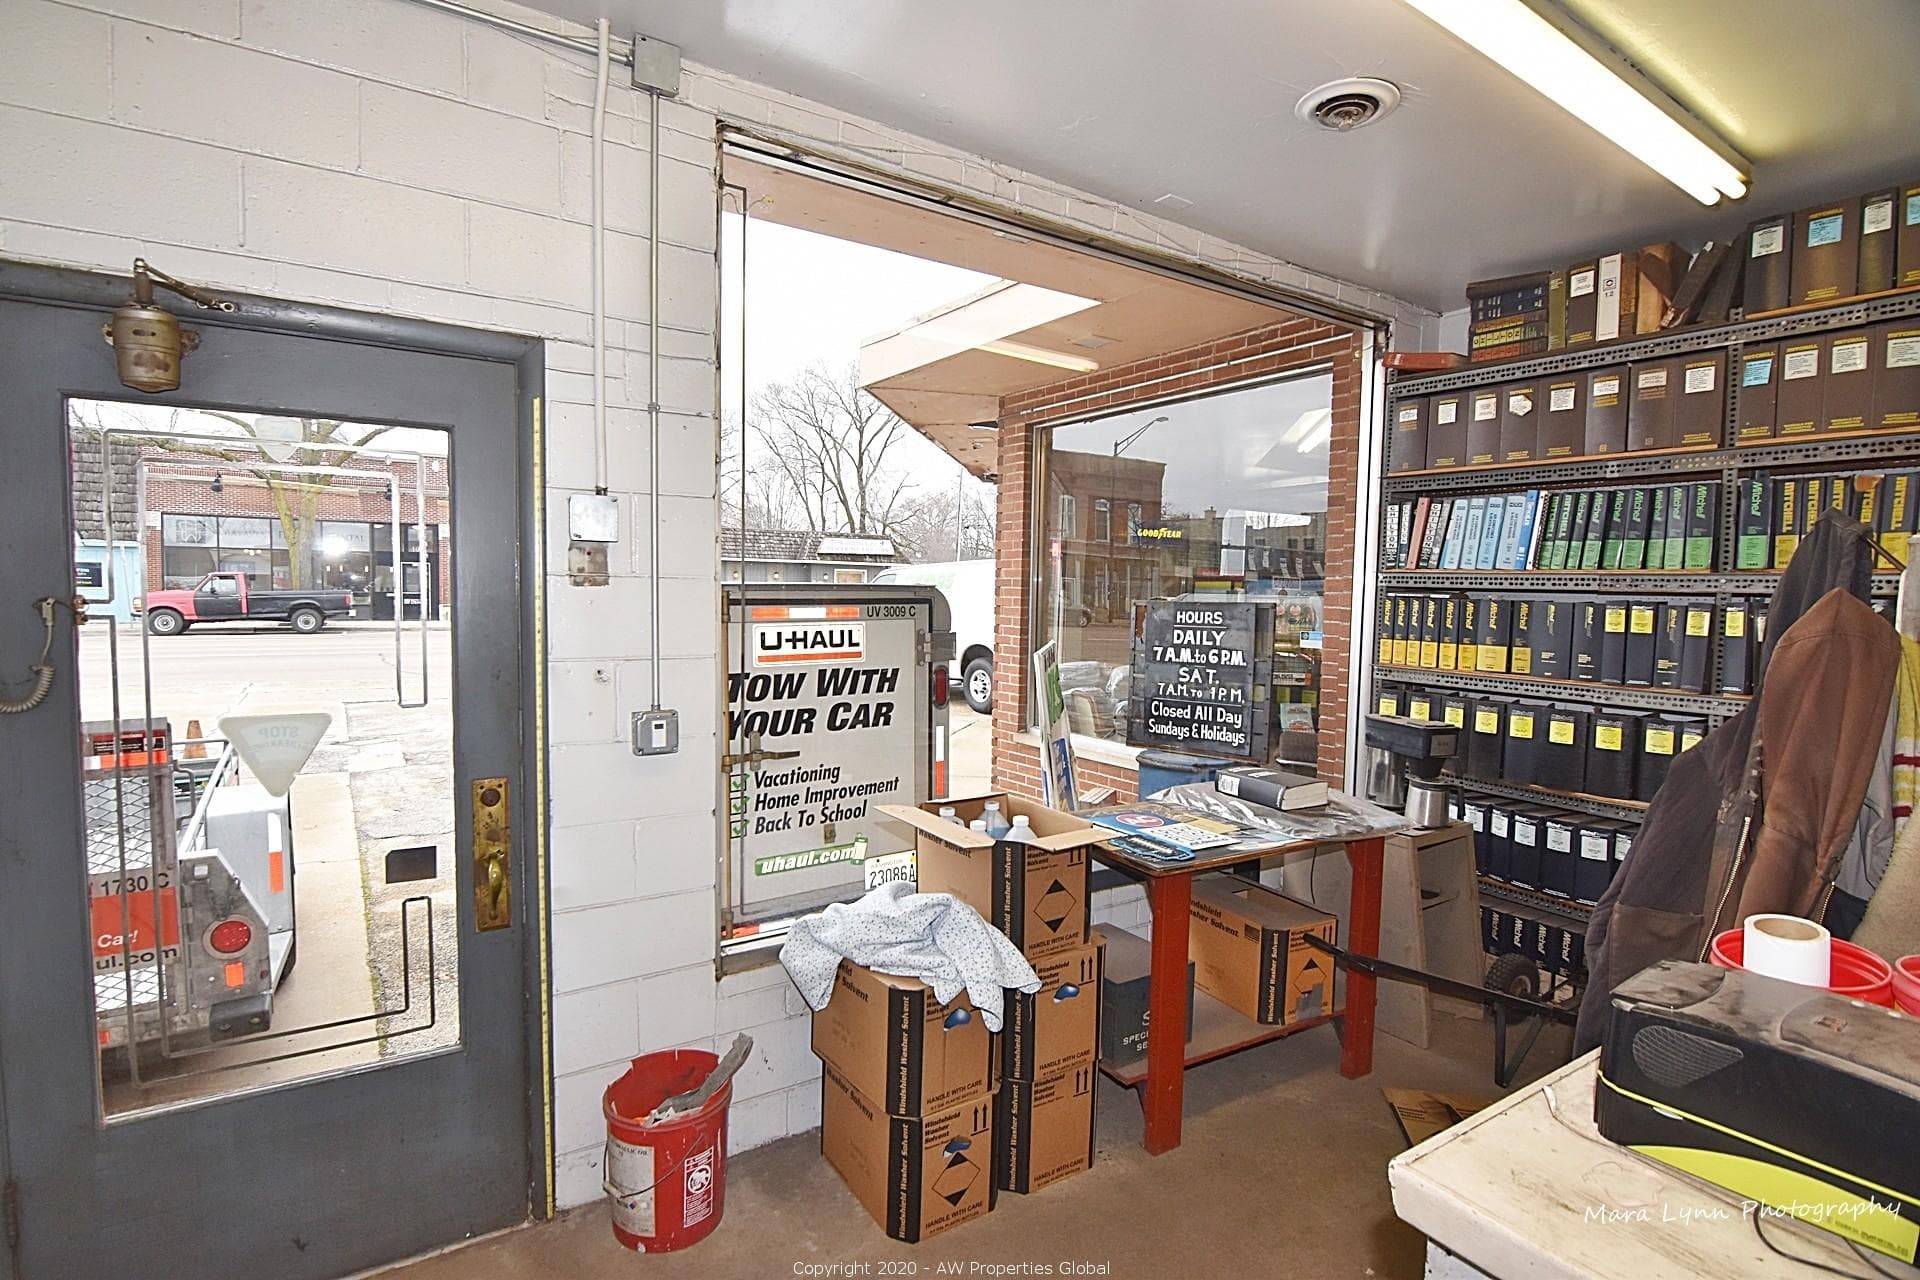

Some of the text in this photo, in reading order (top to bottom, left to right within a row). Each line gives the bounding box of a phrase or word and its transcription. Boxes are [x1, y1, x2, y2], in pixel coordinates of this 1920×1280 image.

[1751, 480, 1763, 517] Mitchell
[1891, 476, 1908, 530] MITCHELL
[1137, 527, 1182, 539] GOODYEAR
[1387, 505, 1399, 548] CHILTON
[1423, 503, 1441, 547] CHILTON
[866, 605, 916, 618] UV 3009 C
[1176, 611, 1223, 625] HOURS
[760, 629, 861, 651] U-HAUL
[1173, 630, 1226, 646] DAILY
[1153, 646, 1164, 661] 7
[1208, 650, 1219, 664] 6
[816, 667, 900, 698] WITH
[1179, 667, 1220, 684] SAT.
[1158, 683, 1165, 695] 7
[1210, 687, 1216, 700] 1
[826, 701, 895, 732] CAR
[1151, 701, 1242, 728] Closed All Day
[1148, 719, 1246, 746] Sundays & Holidays
[754, 763, 841, 789] Vacationing
[755, 776, 900, 812] Home Improvement
[755, 800, 867, 835] Back To School
[1004, 847, 1012, 880] Solvent
[101, 876, 148, 896] 1730
[1191, 900, 1222, 918] ndshield
[1210, 919, 1239, 938] Solvent
[96, 948, 177, 970] ul.com
[842, 976, 869, 1002] Solvent
[1267, 933, 1279, 1023] Windshield Washer Solvent
[1123, 1030, 1149, 1046] SPECI
[899, 996, 910, 1115] Windshield Washer Solvent
[1040, 1059, 1061, 1071] HANDLE
[926, 1079, 983, 1105] HANDLE WITH CARE
[850, 1090, 874, 1122] Solvent
[925, 1111, 961, 1129] Windshield
[925, 1124, 950, 1137] Washer
[925, 1130, 950, 1145] Solvent
[899, 1192, 907, 1239] Windshield
[926, 1200, 984, 1229] HANDLE WITH CARE
